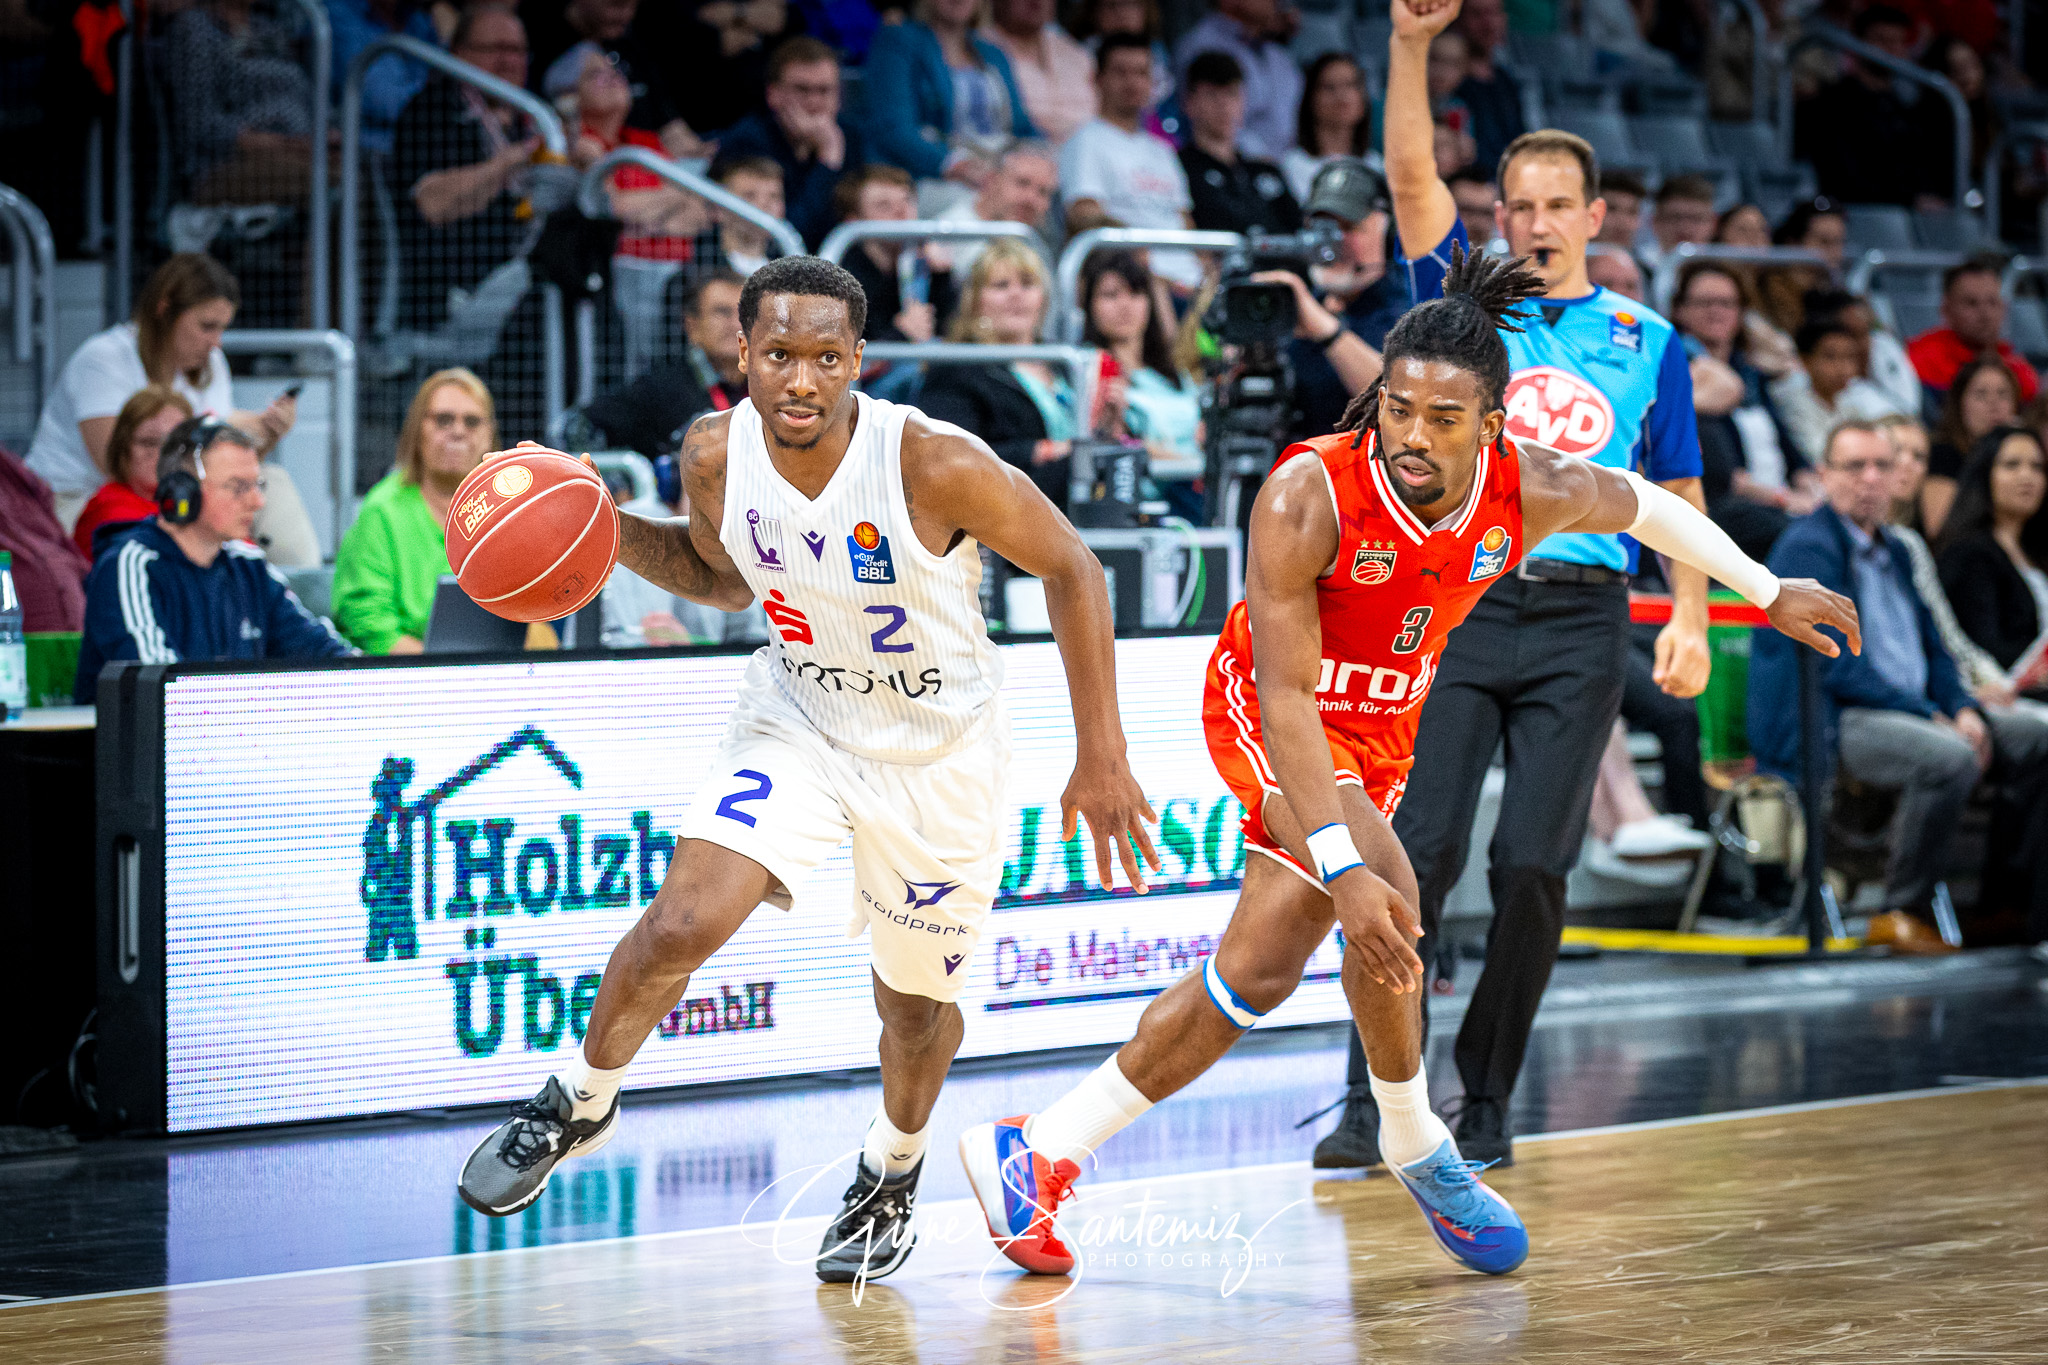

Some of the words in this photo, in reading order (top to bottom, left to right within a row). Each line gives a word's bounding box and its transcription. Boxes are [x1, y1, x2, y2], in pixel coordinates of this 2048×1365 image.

[464, 499, 495, 534] BBL
[857, 566, 890, 580] BBL
[865, 559, 888, 567] Credit
[1473, 563, 1498, 578] BBL
[863, 605, 915, 653] 2
[1391, 605, 1434, 655] 3
[1358, 701, 1382, 715] für
[715, 768, 773, 829] 2
